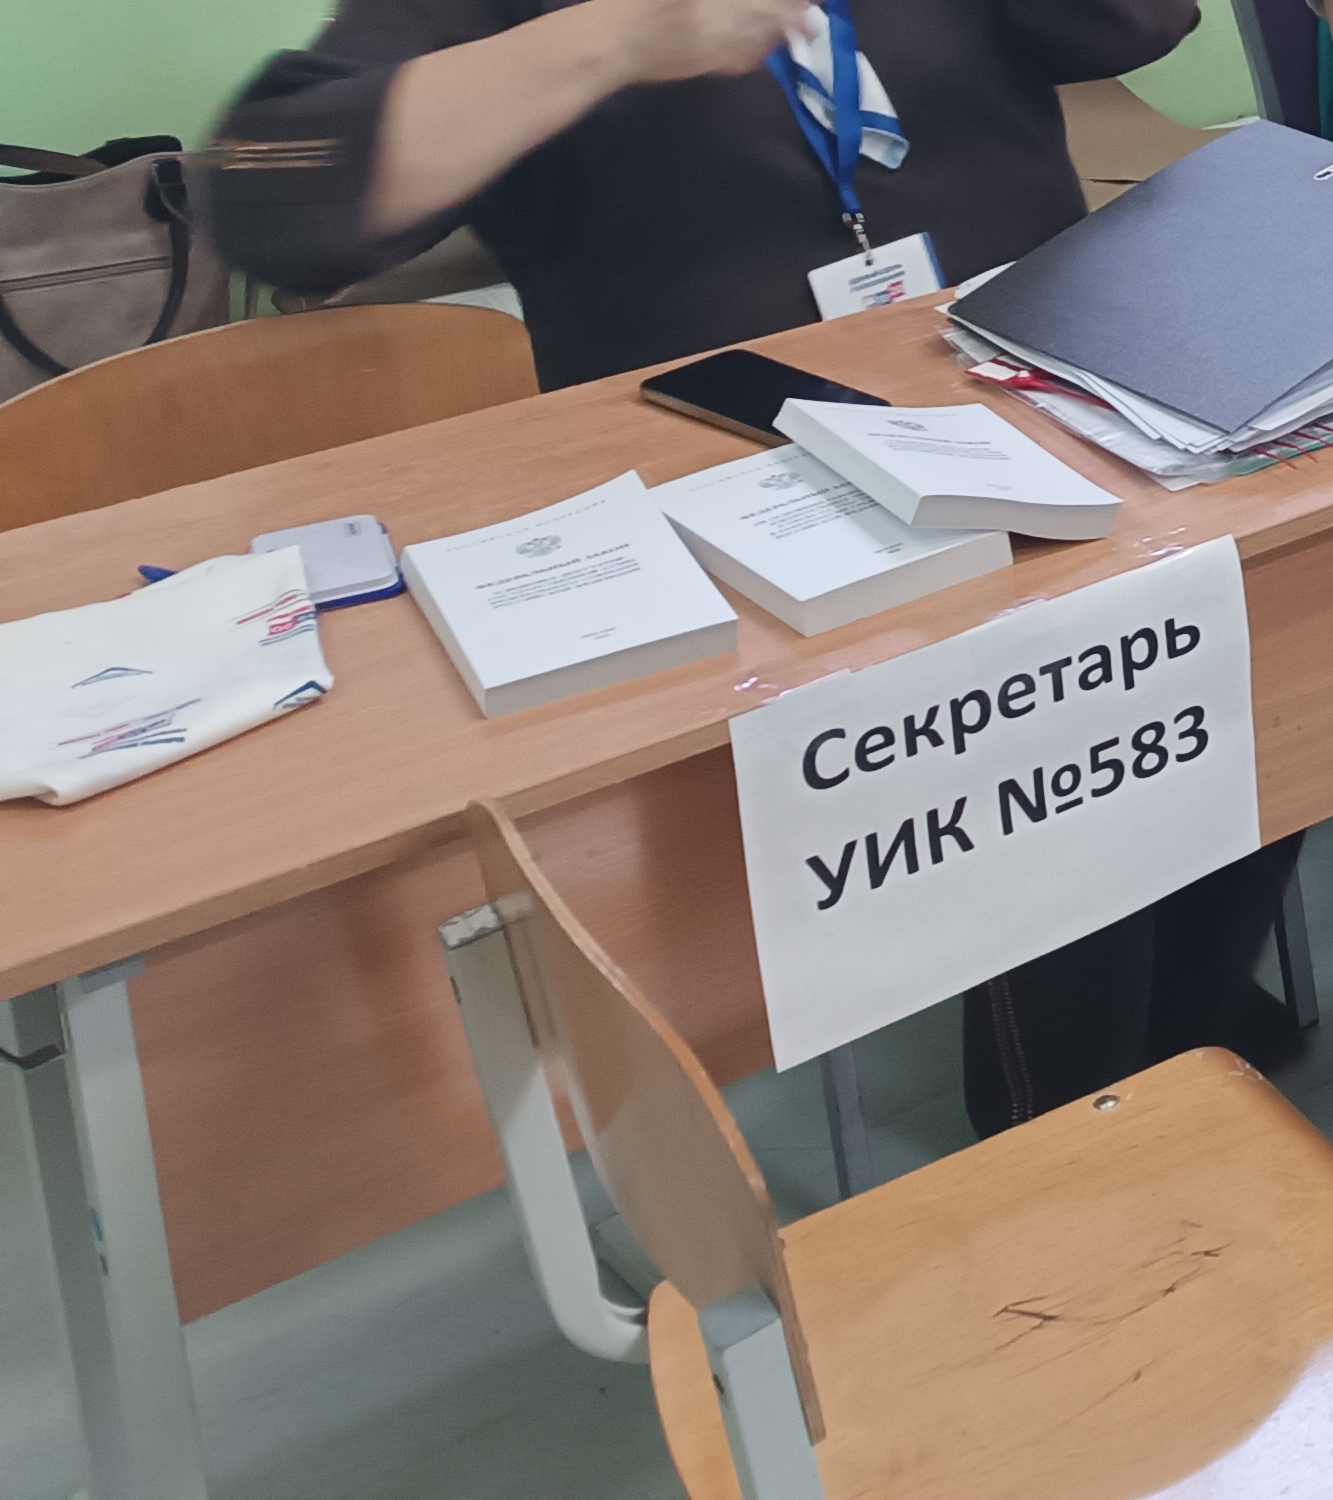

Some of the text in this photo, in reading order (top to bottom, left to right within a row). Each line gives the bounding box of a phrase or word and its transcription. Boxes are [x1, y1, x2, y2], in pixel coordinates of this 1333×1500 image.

[802, 617, 1201, 790] Секретарь
[805, 705, 1210, 911] УИК №583
